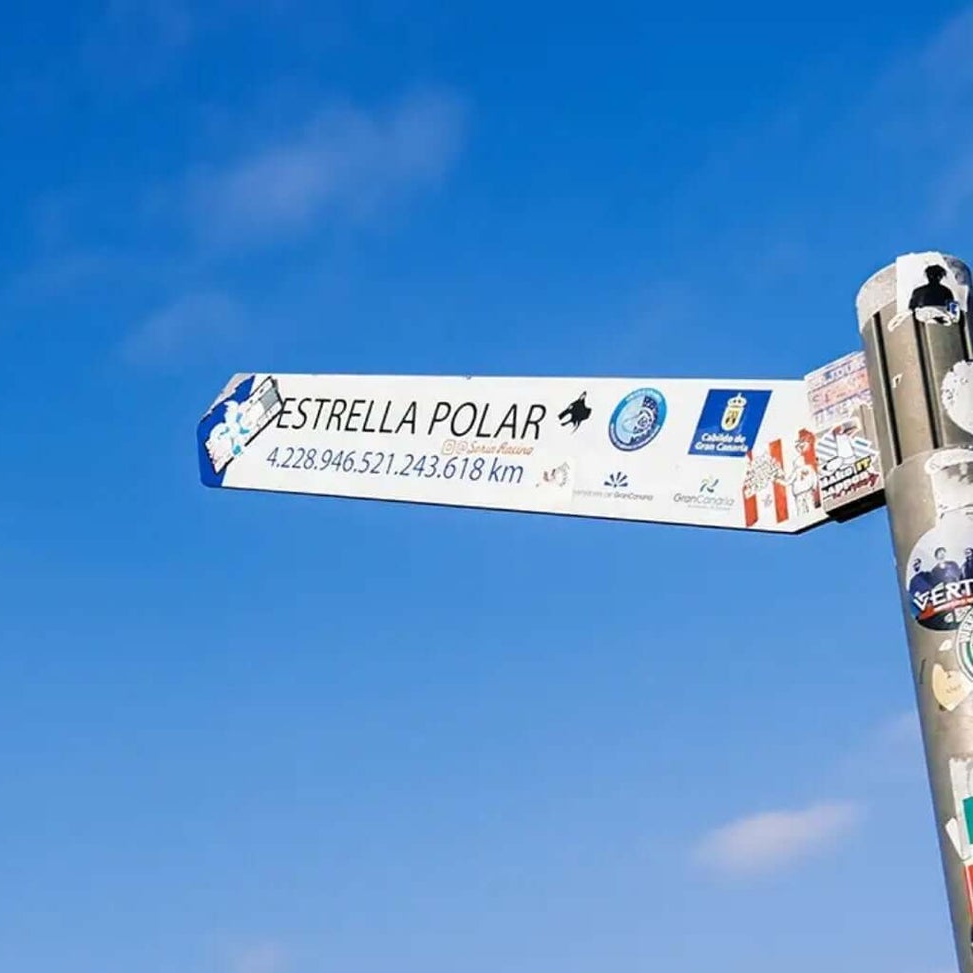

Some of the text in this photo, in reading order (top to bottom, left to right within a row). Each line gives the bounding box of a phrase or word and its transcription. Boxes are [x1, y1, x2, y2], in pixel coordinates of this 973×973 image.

[276, 397, 547, 440] ESTRELLA POLAR
[695, 441, 749, 452] Gran Canaria
[701, 432, 733, 443] Cabildo
[266, 446, 524, 484] 4.228.946.521.243.618 km
